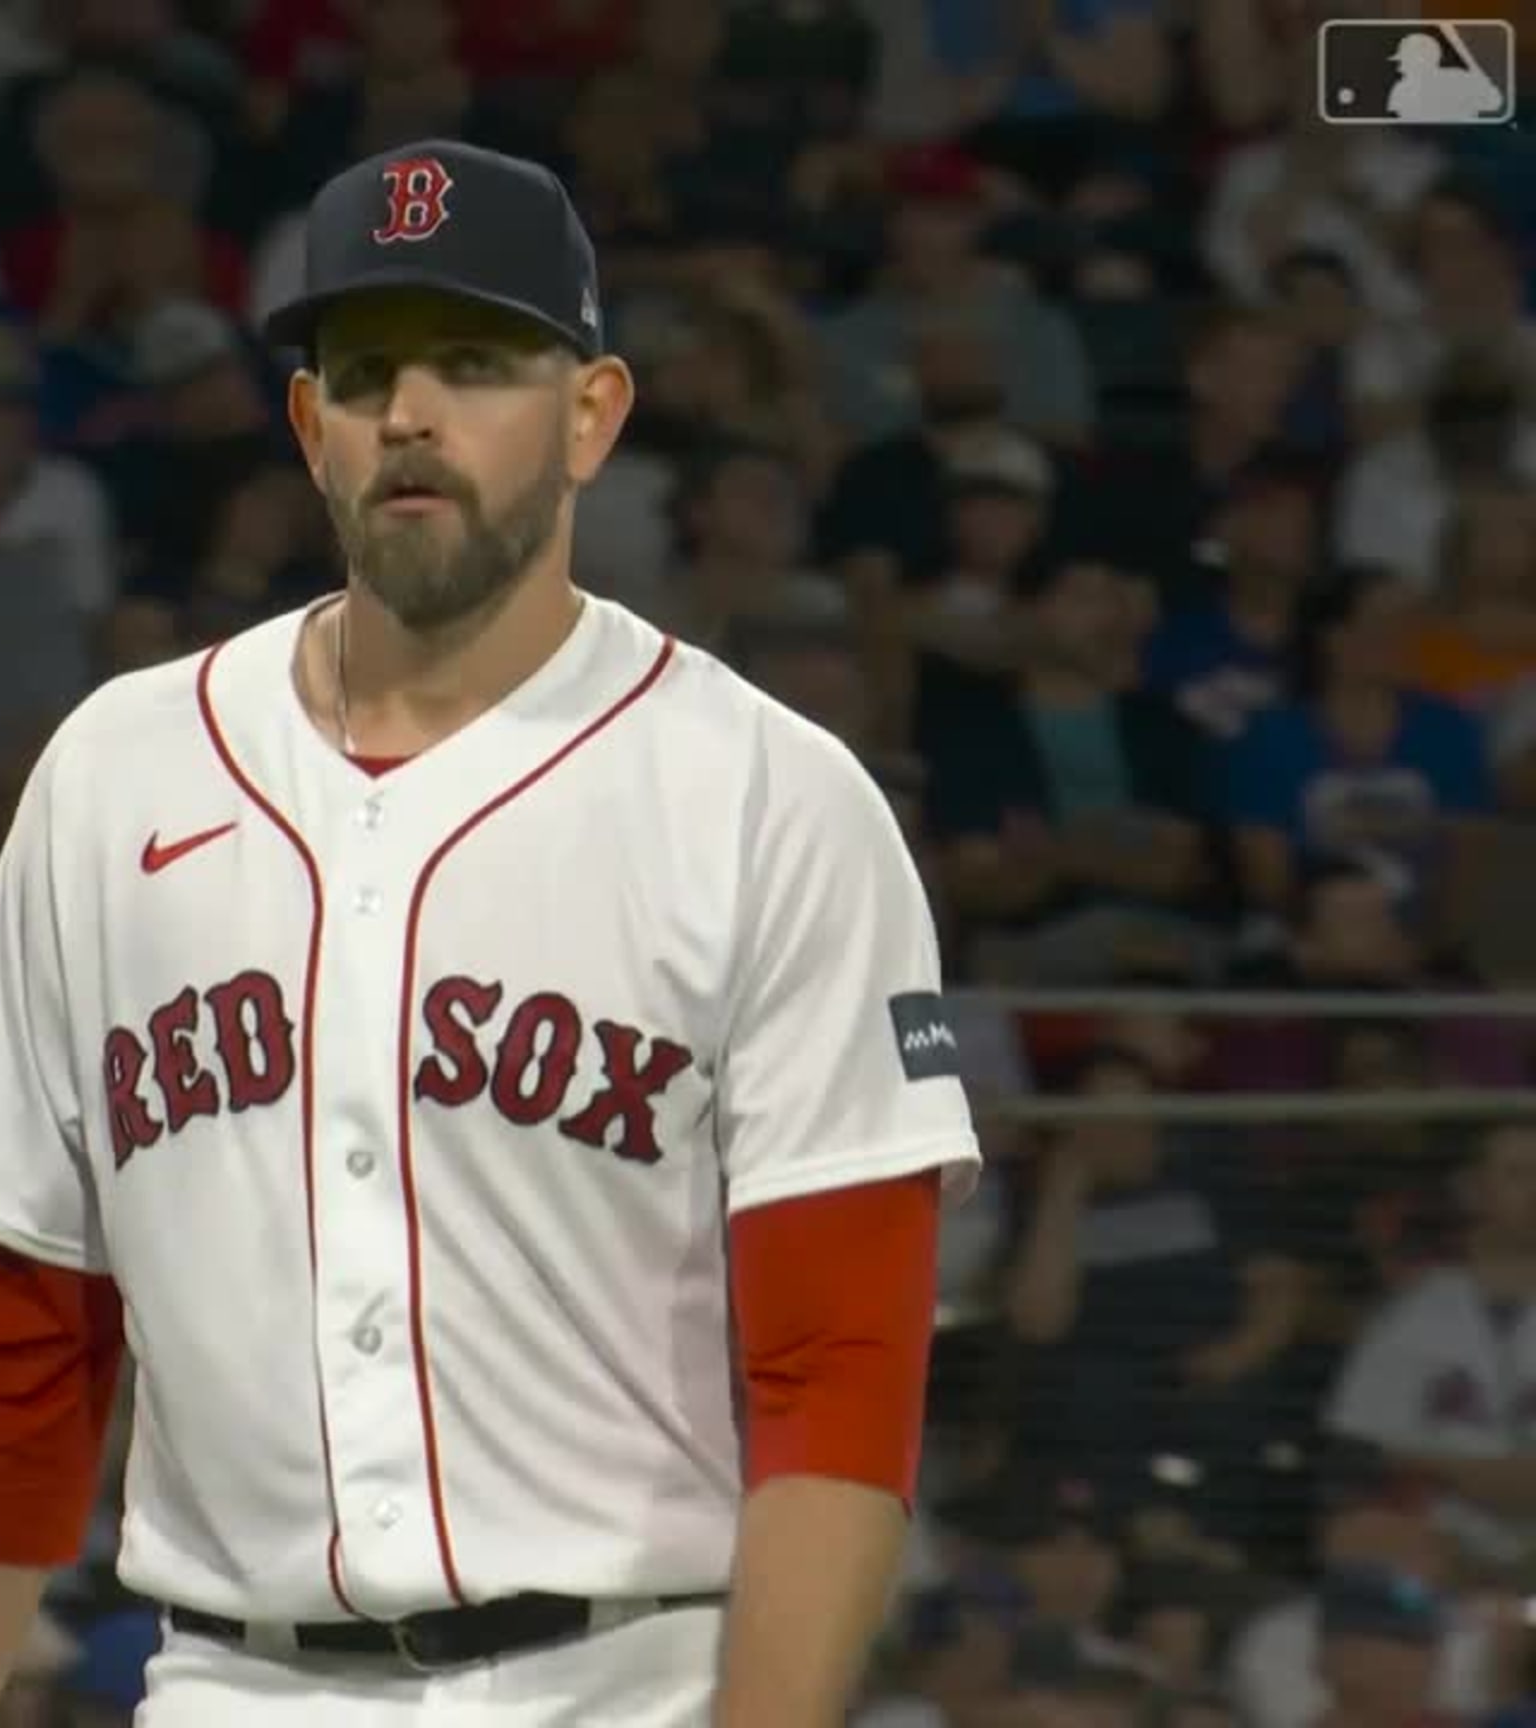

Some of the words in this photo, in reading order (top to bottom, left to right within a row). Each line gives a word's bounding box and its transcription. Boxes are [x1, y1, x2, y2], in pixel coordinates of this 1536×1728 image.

[371, 156, 453, 244] B
[104, 969, 295, 1172] RED
[414, 975, 693, 1165] SOX
